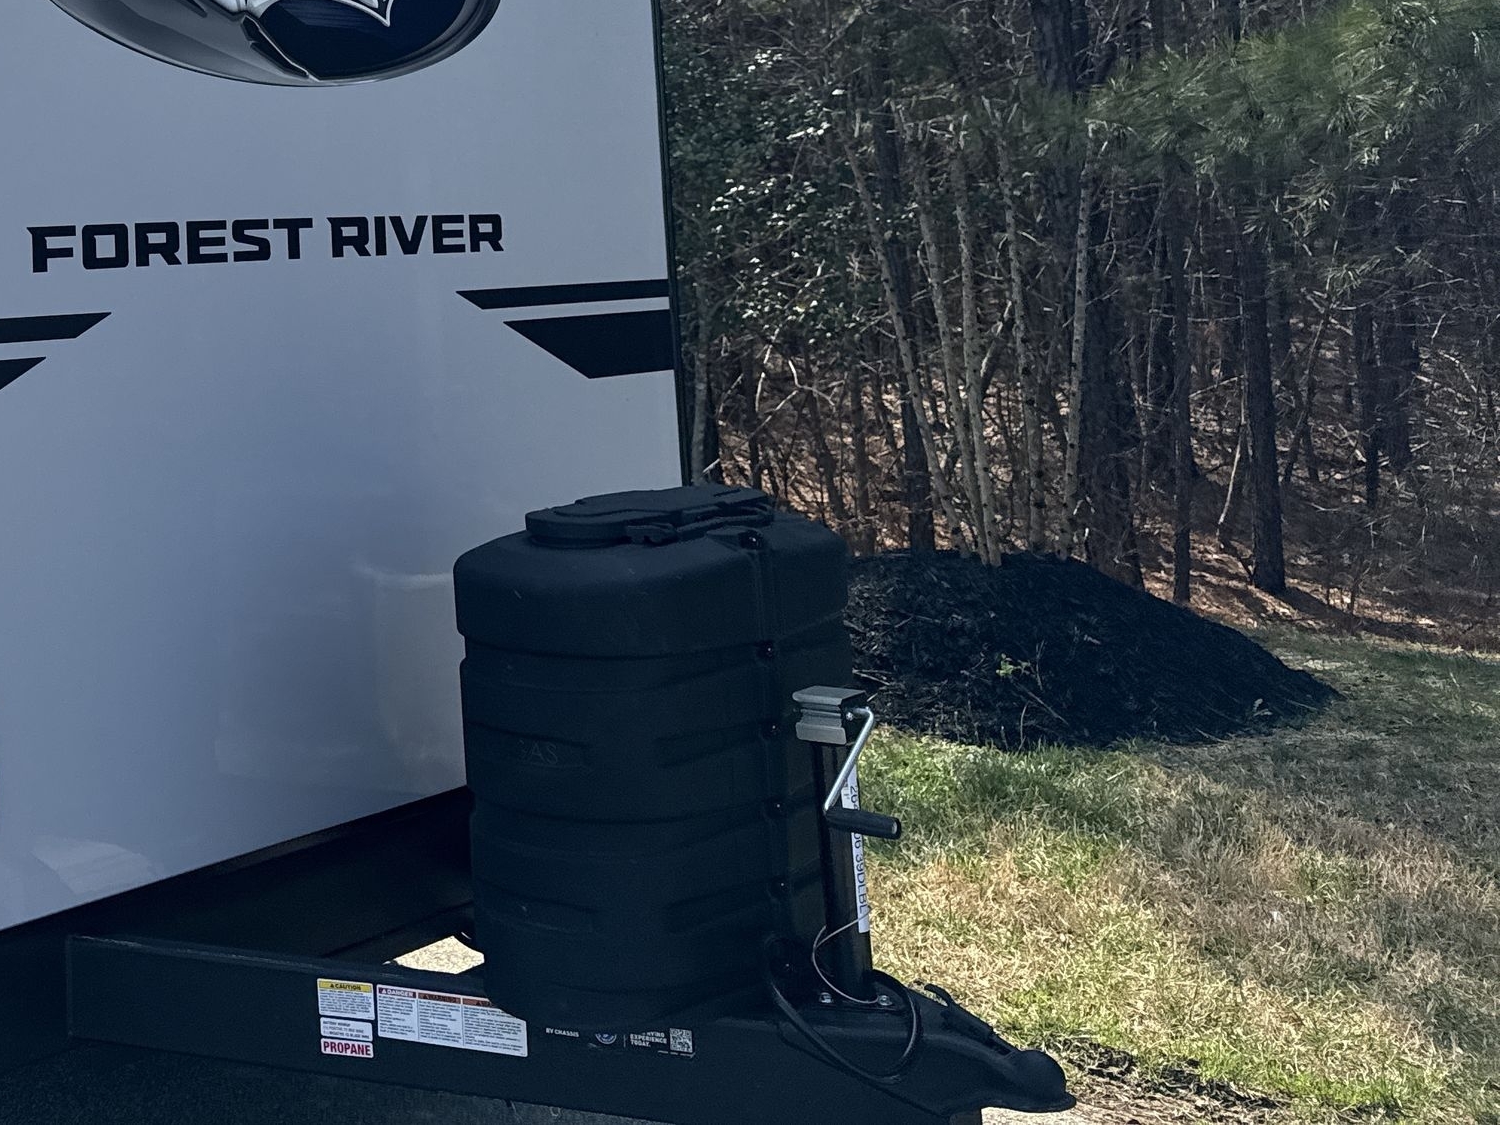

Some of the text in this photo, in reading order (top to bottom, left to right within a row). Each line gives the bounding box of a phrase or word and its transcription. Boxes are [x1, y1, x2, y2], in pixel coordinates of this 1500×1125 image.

[26, 214, 504, 273] FOREST RIVER
[335, 983, 361, 991] CAUTION
[387, 989, 414, 997] DANGER
[554, 1029, 579, 1038] CHASSIS
[630, 1033, 667, 1044] EXPERIENCE
[323, 1041, 371, 1056] PROPANE
